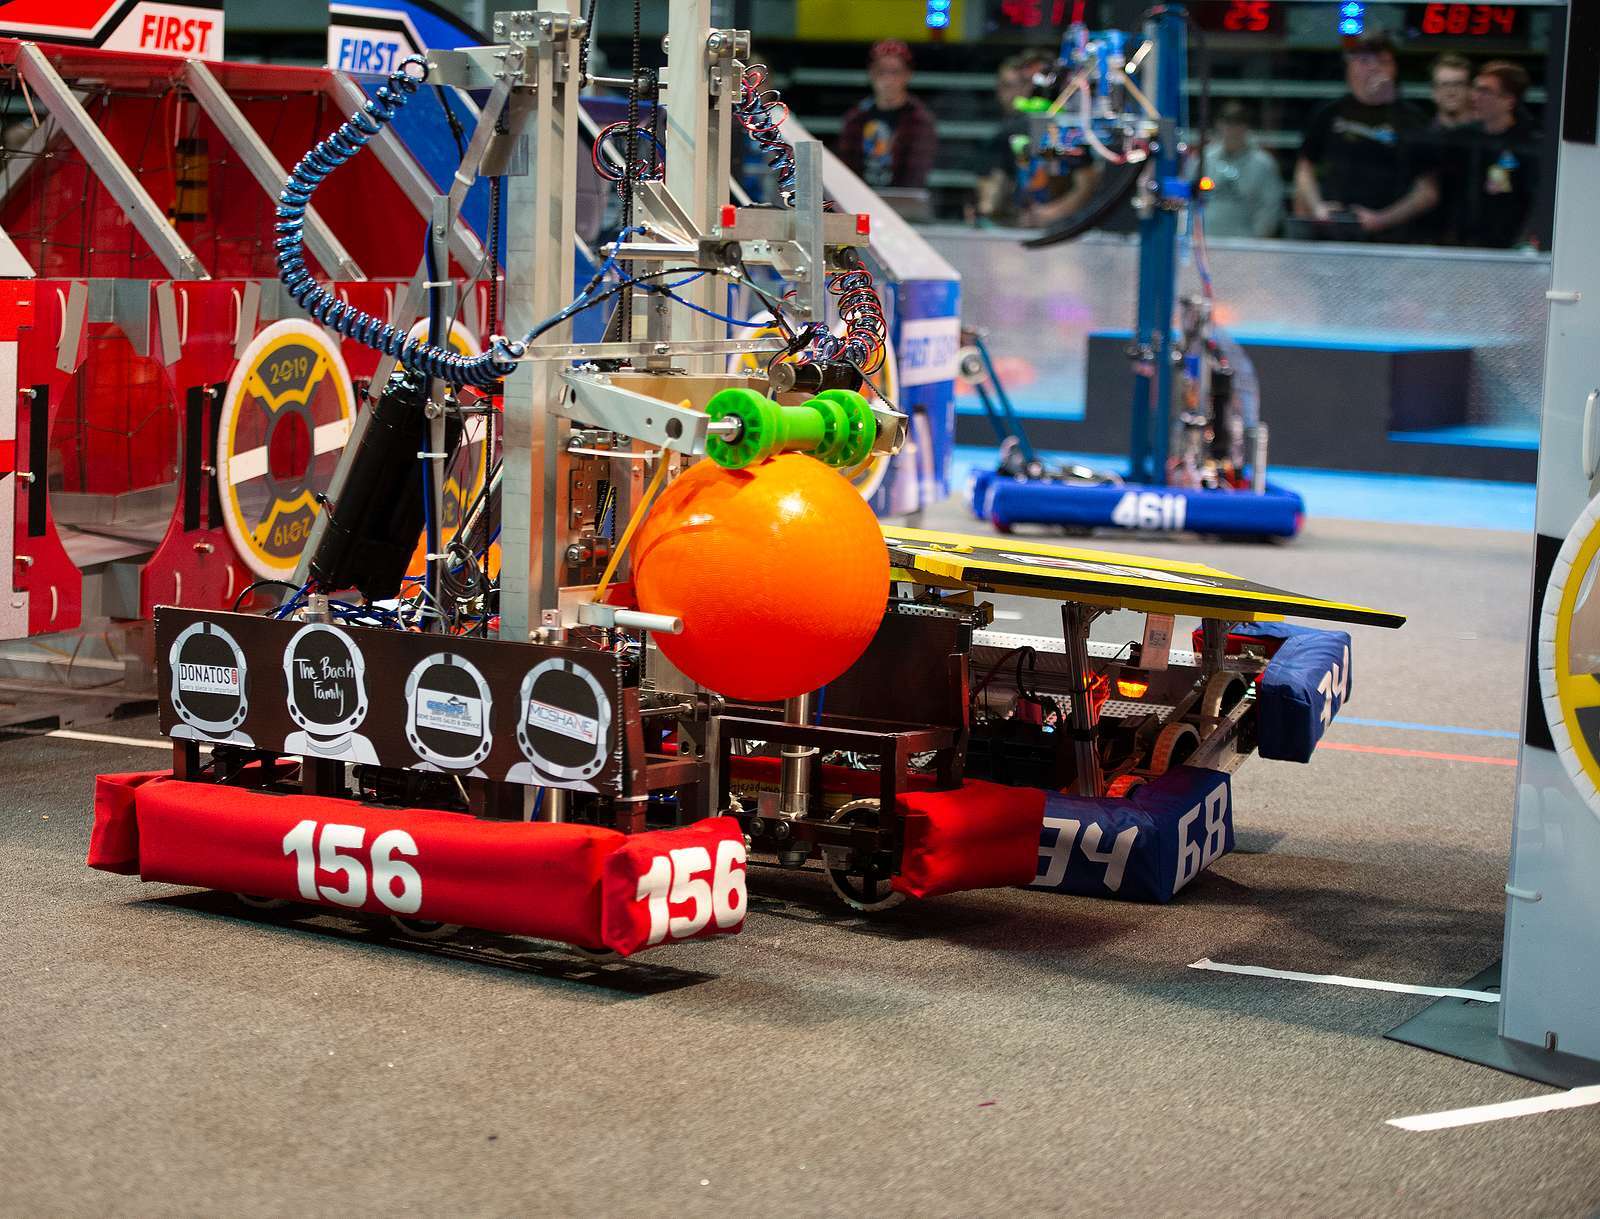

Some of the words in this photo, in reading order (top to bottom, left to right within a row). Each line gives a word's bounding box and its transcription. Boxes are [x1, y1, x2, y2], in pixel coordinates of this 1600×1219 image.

[140, 14, 213, 53] FIRST
[1421, 3, 1515, 35] 6834
[339, 38, 398, 71] FIRST
[270, 356, 308, 384] 2019
[1111, 491, 1187, 530] 4611
[180, 664, 231, 685] DONATOS
[293, 658, 318, 680] The
[313, 680, 344, 717] Family
[1172, 782, 1228, 895] 68
[282, 820, 423, 914] 156
[635, 839, 748, 945] 156
